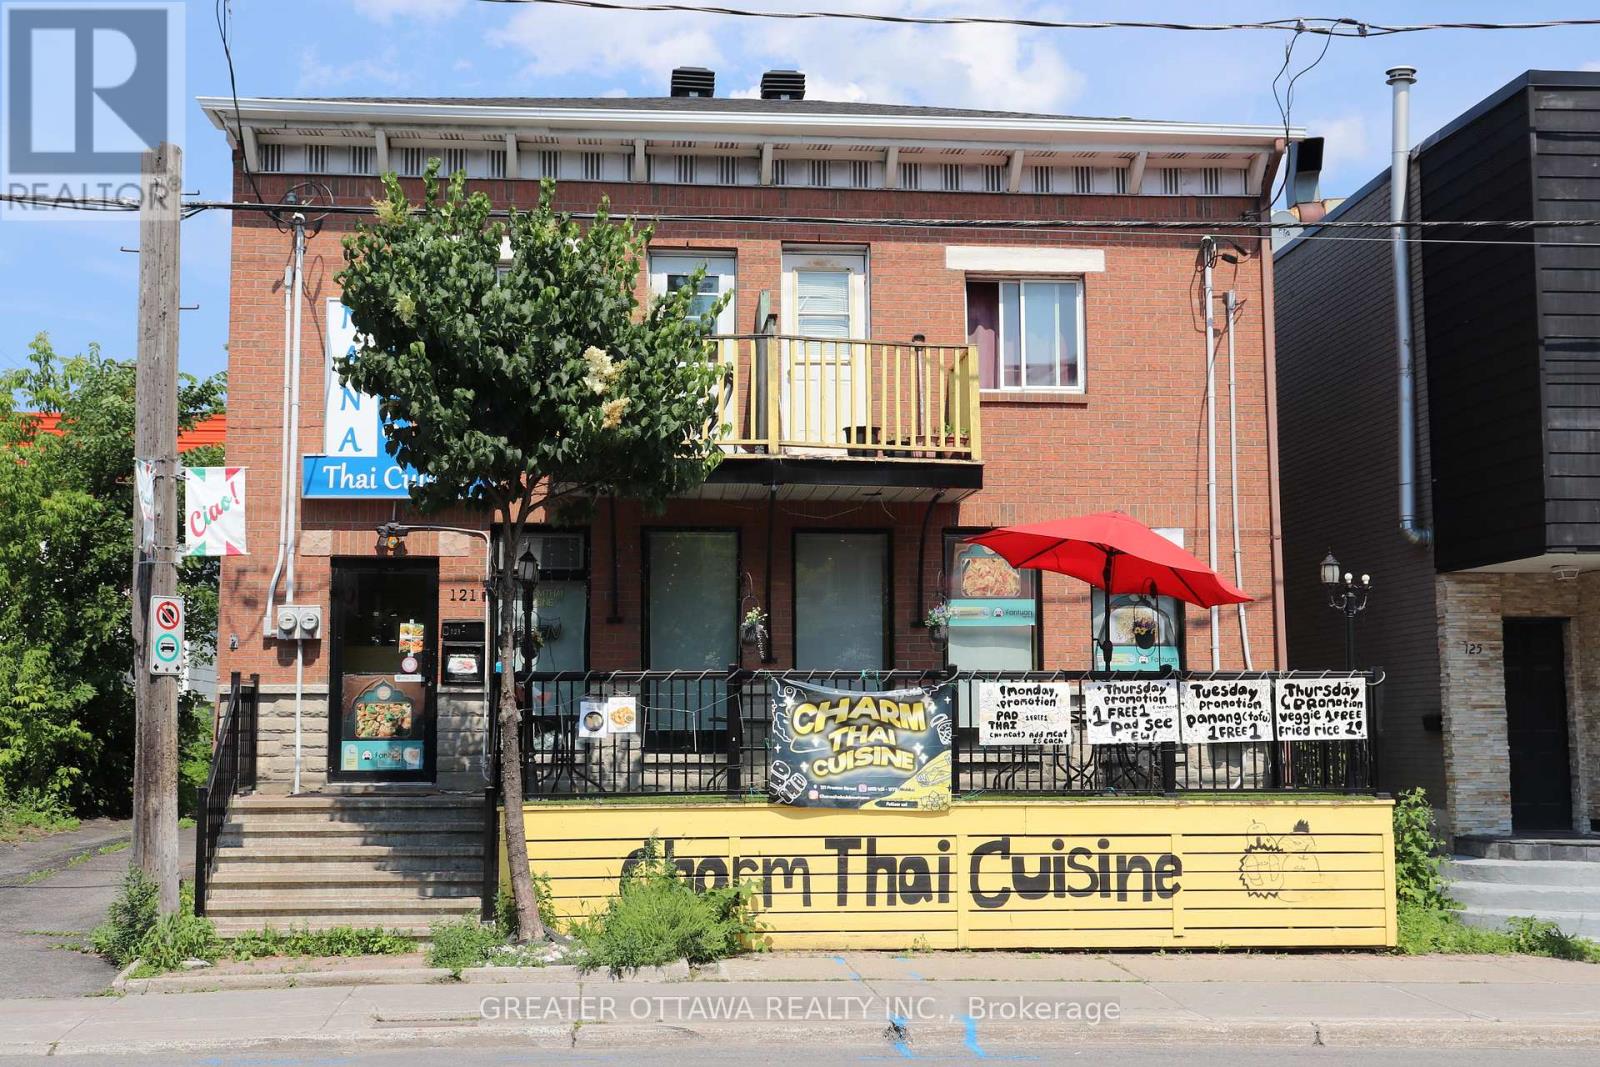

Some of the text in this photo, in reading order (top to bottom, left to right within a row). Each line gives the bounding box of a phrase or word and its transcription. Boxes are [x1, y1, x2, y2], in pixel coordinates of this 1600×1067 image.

[323, 462, 378, 489] Thai
[190, 481, 240, 538] Ciao!
[450, 589, 476, 602] 121
[1463, 641, 1482, 655] 125
[1104, 682, 1166, 695] Thursday
[1190, 683, 1258, 701] Tuesday
[1284, 682, 1360, 700] Thursday
[1000, 696, 1057, 709] promotion
[1199, 698, 1262, 711] promotion
[793, 696, 926, 735] CHARM
[996, 711, 1019, 721] PAD
[1279, 710, 1321, 725] veggie
[988, 721, 1018, 731] THAI
[1315, 723, 1340, 736] rice
[828, 725, 896, 752] THAI
[813, 746, 914, 776] CUISINE
[825, 837, 951, 907] Thai
[970, 836, 1183, 908] Cuisine
